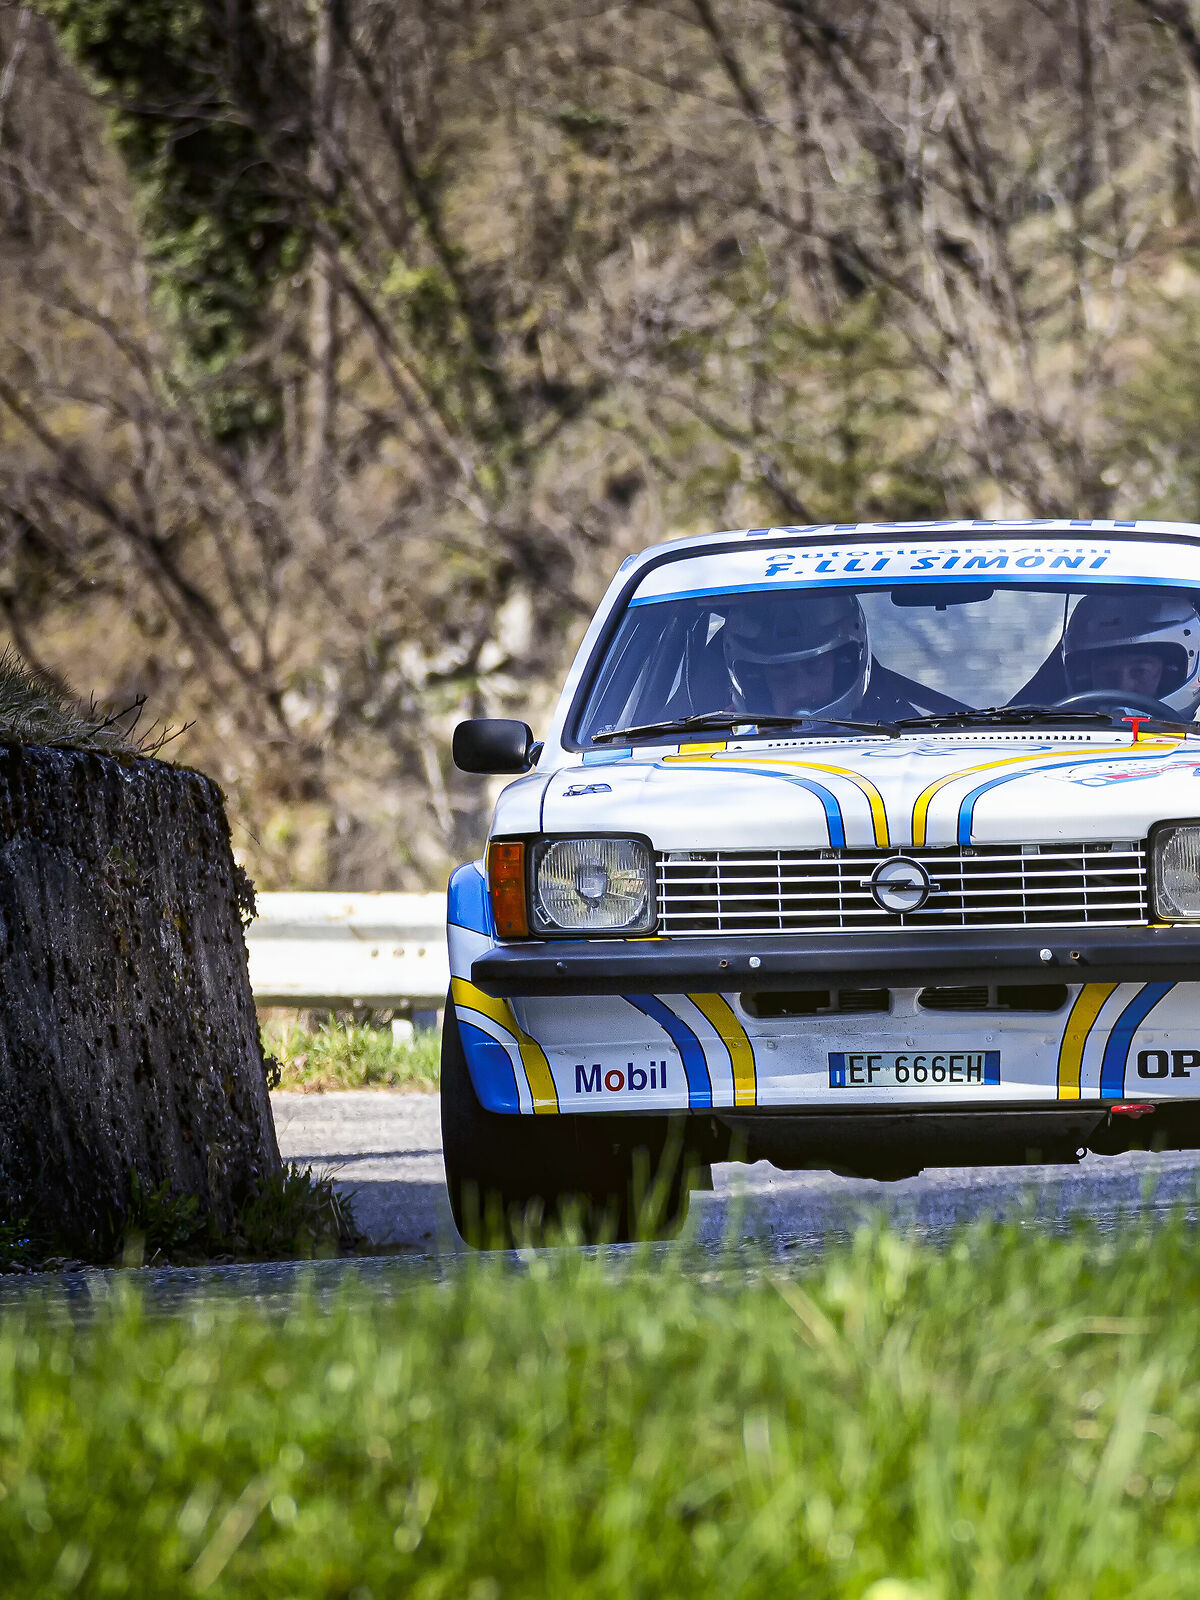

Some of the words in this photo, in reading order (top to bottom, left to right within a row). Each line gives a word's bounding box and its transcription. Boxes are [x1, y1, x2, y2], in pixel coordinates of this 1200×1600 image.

[910, 556, 1108, 570] SIMONI
[575, 1061, 667, 1093] Mobil
[850, 1055, 882, 1084] EF
[895, 1055, 982, 1084] 666EH
